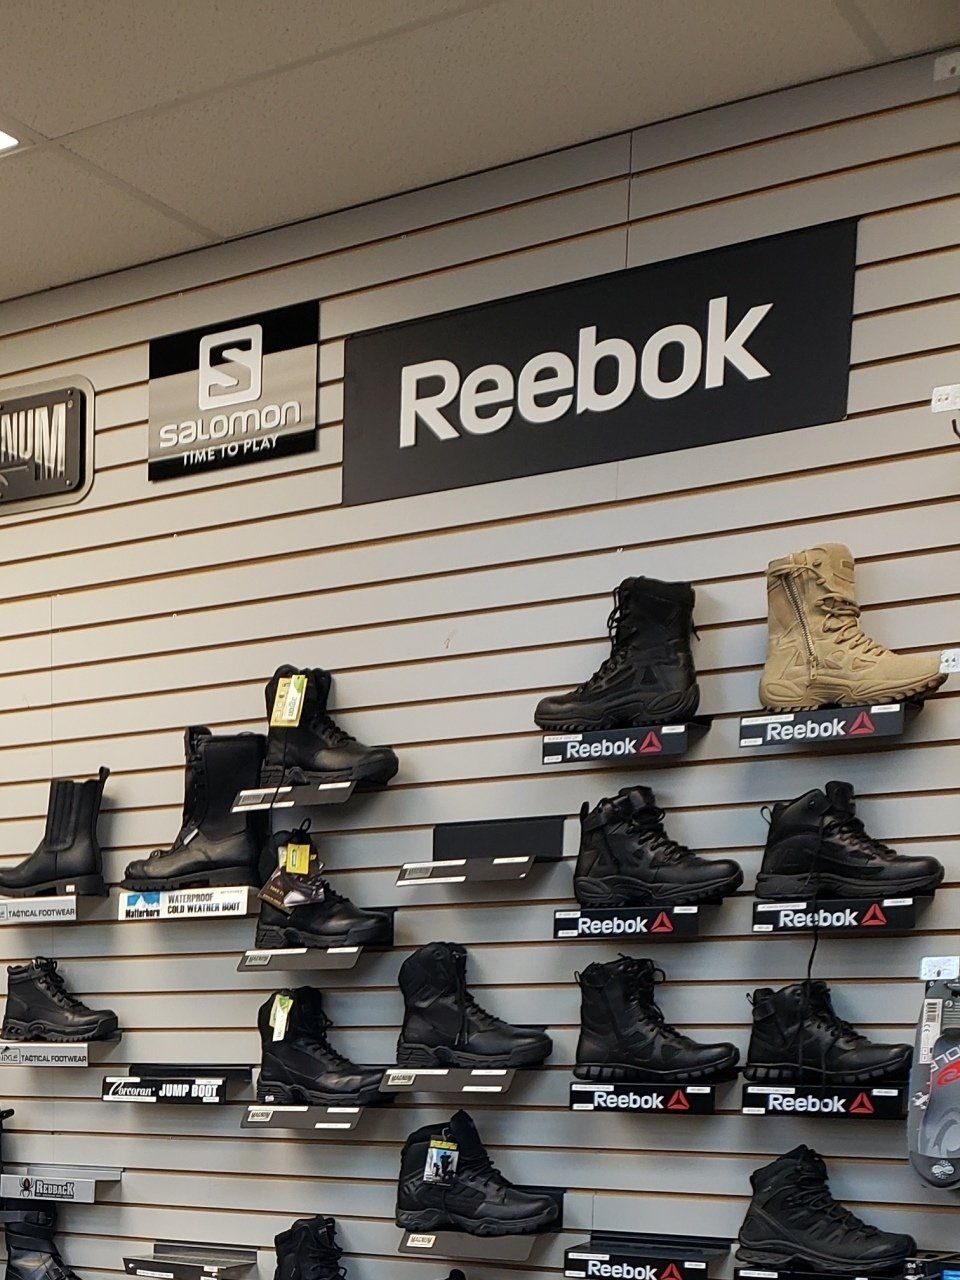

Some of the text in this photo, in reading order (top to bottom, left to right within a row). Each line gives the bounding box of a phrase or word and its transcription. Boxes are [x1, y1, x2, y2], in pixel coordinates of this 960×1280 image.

[399, 296, 774, 449] Reebok
[182, 434, 280, 466] TIME TO PLAY
[766, 718, 846, 741] Reebok
[566, 738, 637, 759] Reebok
[168, 892, 214, 904] WATERPROOF
[8, 907, 75, 918] TACTICAL FOOTWEAR
[167, 902, 240, 914] COLD WEATHER BOOT
[578, 915, 648, 934] Reebok
[779, 909, 859, 928] Reebok
[21, 1053, 87, 1063] TACTICAL FOOTWEAR
[108, 1081, 218, 1098] Corcoran JUMP BOOT
[593, 1091, 664, 1110] Reebok
[768, 1094, 847, 1114] Reebok
[35, 1180, 74, 1197] REDBACK
